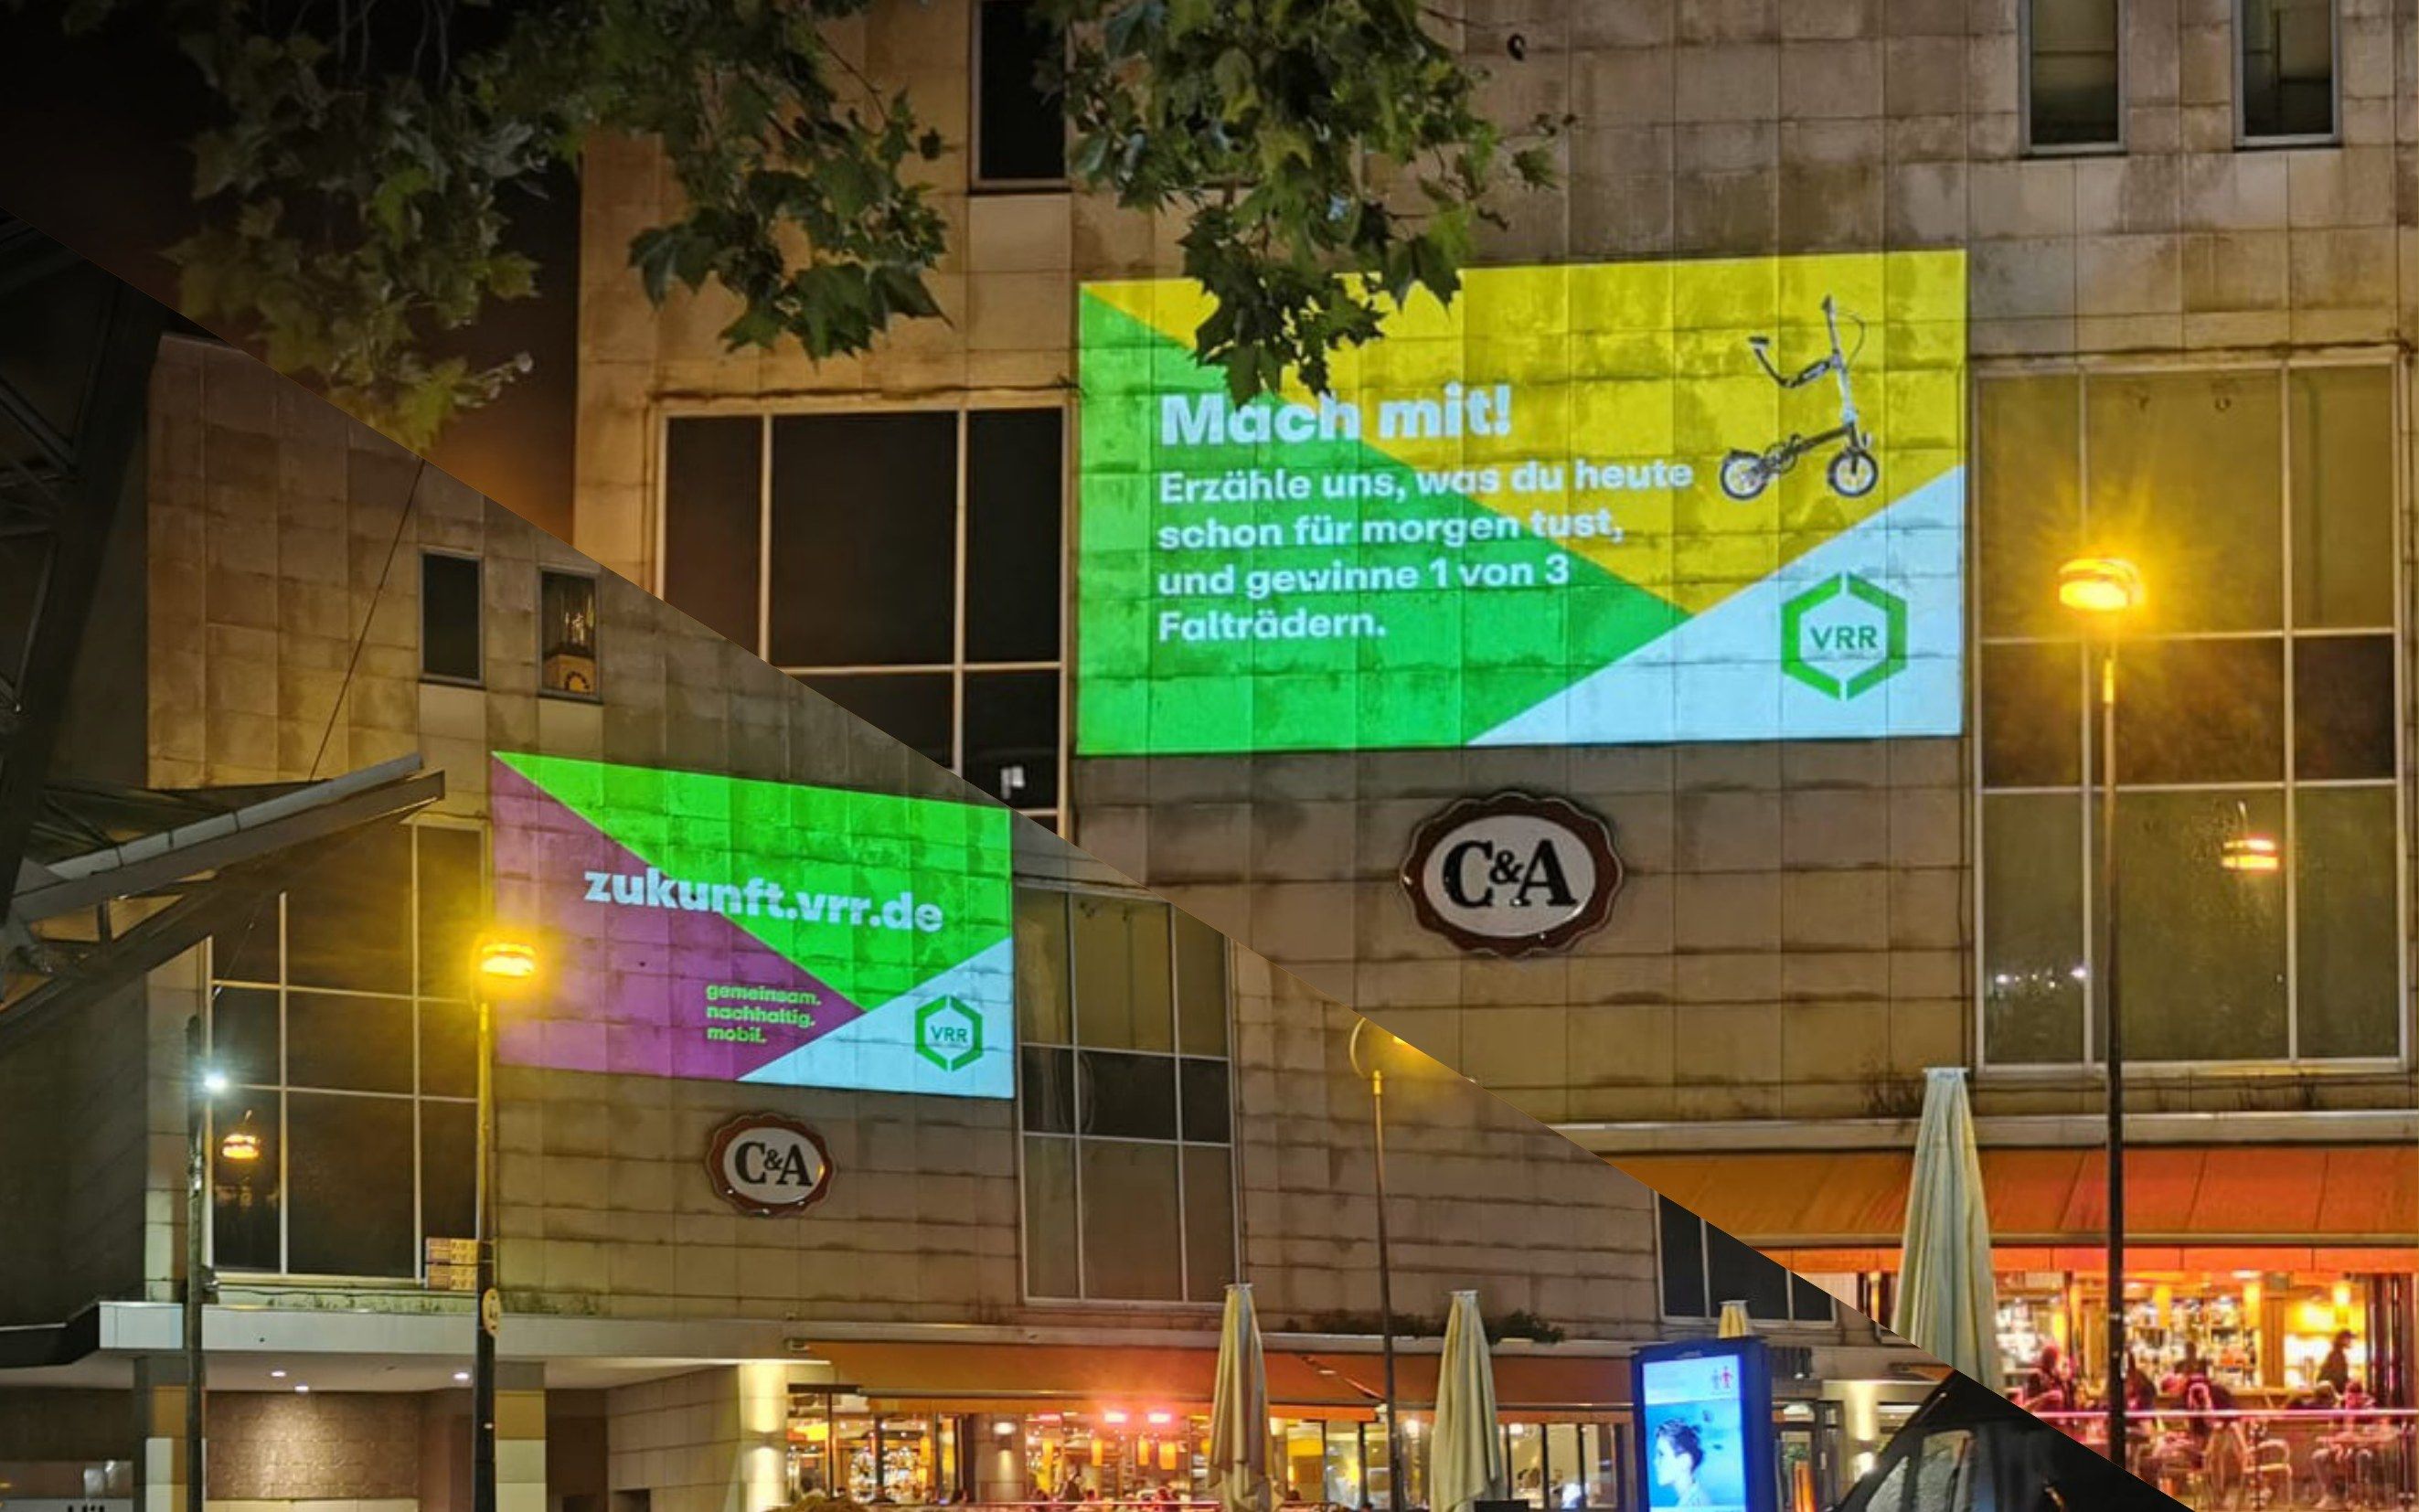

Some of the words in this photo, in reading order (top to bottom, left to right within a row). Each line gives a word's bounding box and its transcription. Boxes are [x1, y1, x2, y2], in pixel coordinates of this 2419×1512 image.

[1160, 389, 1360, 446] Mach
[1378, 381, 1512, 439] mit!
[1159, 468, 1313, 504] Erzähle
[1322, 471, 1407, 503] uns,
[1416, 468, 1500, 495] was
[1511, 459, 1565, 492] du
[1574, 458, 1694, 492] heute
[1157, 516, 1284, 550] schon
[1293, 514, 1353, 546] für
[1362, 516, 1520, 548] morgen
[1529, 507, 1625, 544] tust,
[1158, 562, 1235, 595] und
[1246, 559, 1420, 601] gewinne
[1429, 557, 1449, 589] 1
[1458, 561, 1535, 588] von
[1544, 551, 1571, 585] 3
[1158, 606, 1387, 642] Falträdern.
[1810, 624, 1878, 651] VRR
[1442, 837, 1579, 909] C&A
[583, 868, 944, 933] zukunft.vrr.de
[706, 985, 822, 1006] gemeinsam.
[706, 1005, 816, 1029] nachhaltig.
[706, 1026, 768, 1044] mobil.
[930, 1024, 969, 1043] VRR
[734, 1140, 814, 1187] C&A
